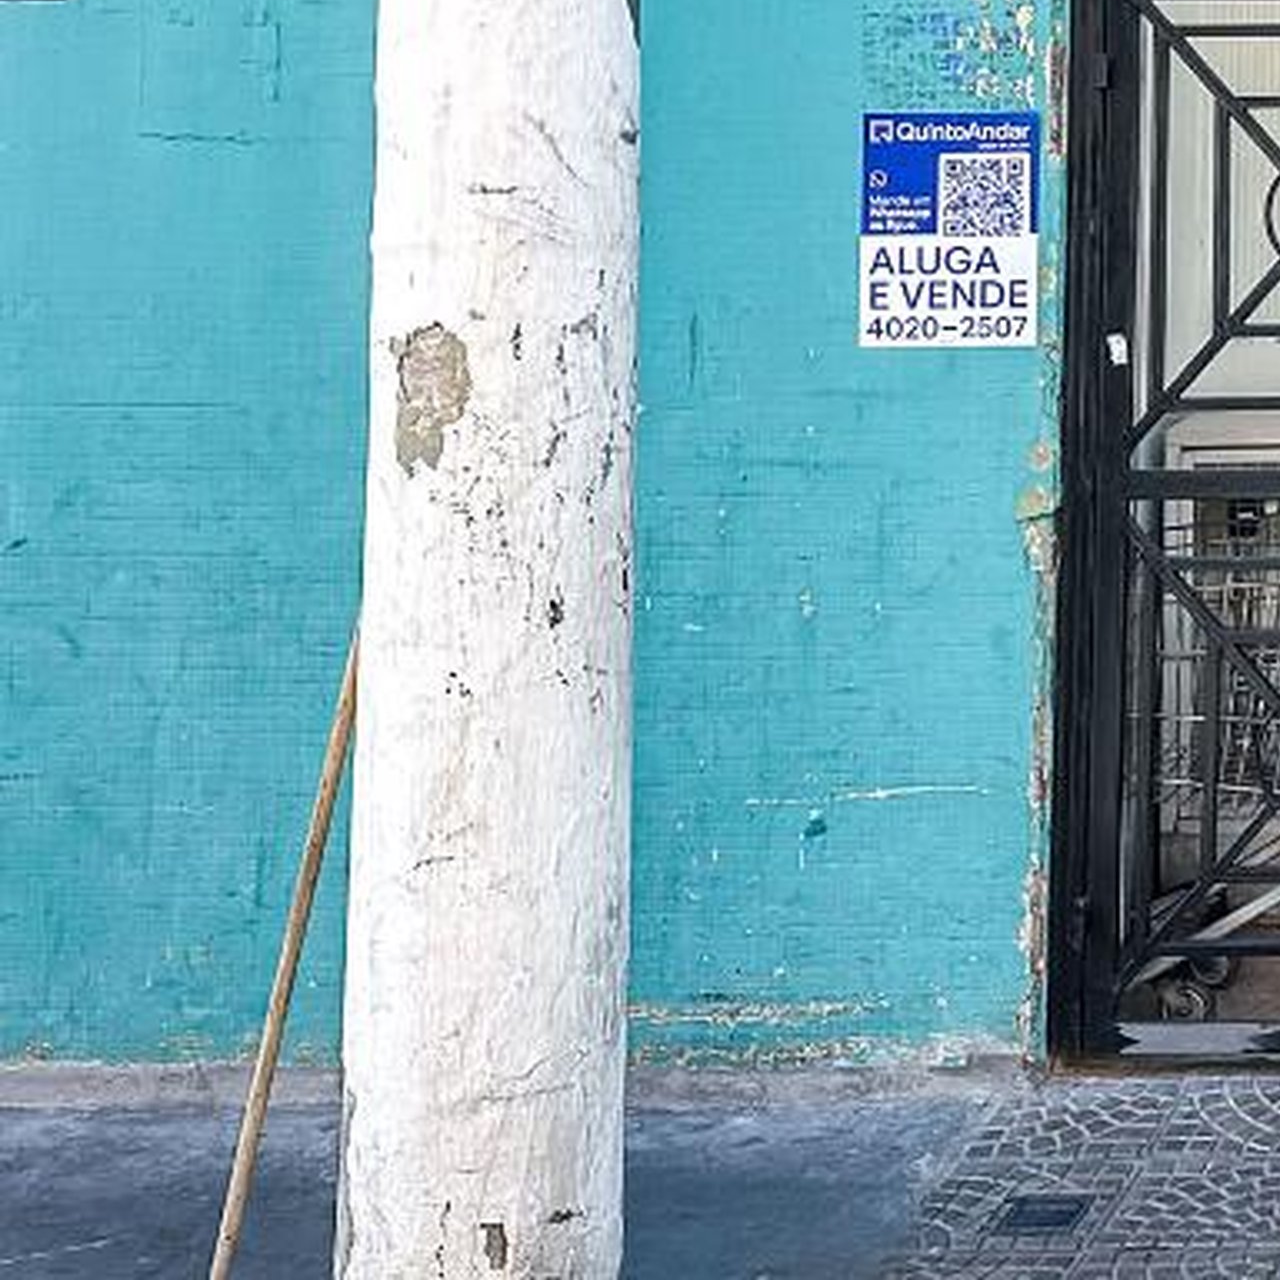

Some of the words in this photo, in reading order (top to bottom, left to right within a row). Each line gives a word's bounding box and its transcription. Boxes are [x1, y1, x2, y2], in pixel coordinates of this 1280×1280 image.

[895, 122, 1031, 142] QuintoAndar
[869, 246, 1001, 275] ALUGA
[869, 281, 889, 310] E
[901, 279, 1028, 310] VENDE
[866, 316, 1028, 341] 4020-2507
